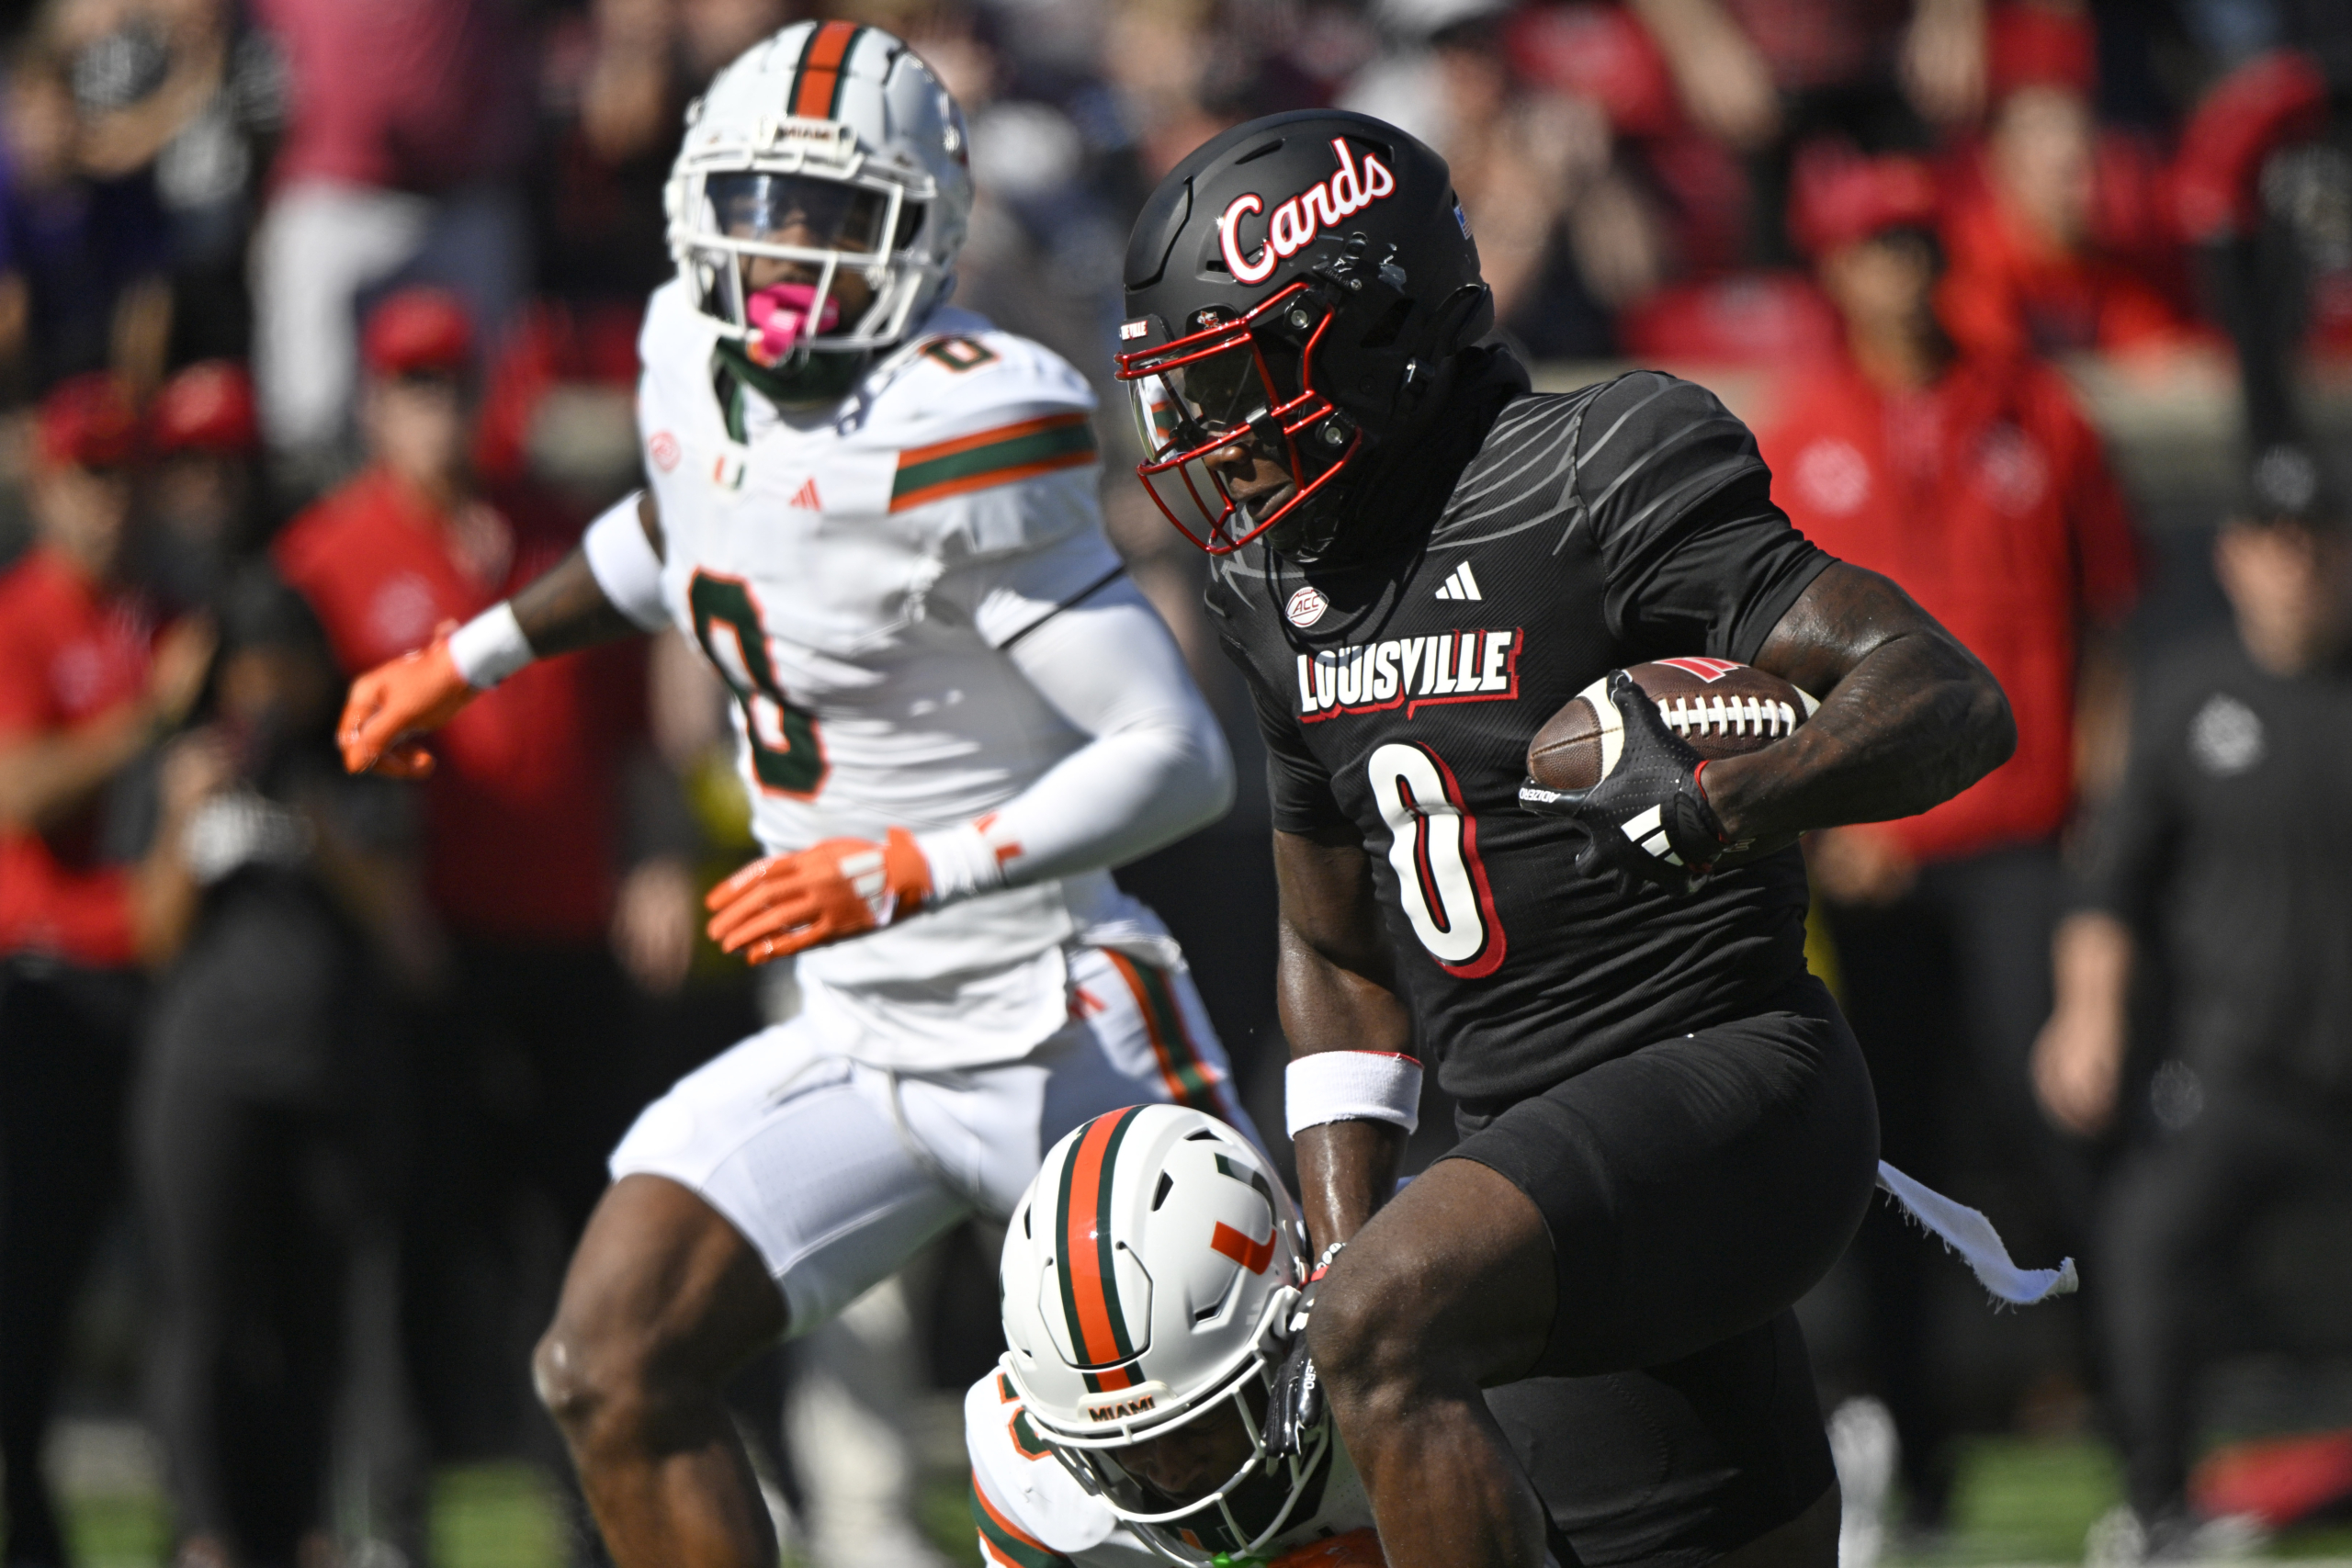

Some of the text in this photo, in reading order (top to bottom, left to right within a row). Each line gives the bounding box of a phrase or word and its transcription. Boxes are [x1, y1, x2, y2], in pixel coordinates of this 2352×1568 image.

[1220, 137, 1396, 283] Cards
[1292, 595, 1319, 615] ACC
[688, 566, 833, 802] 0
[1296, 627, 1523, 721] LOUISVILLE
[1368, 741, 1507, 978] 0
[1088, 1393, 1156, 1423] MIAMI
